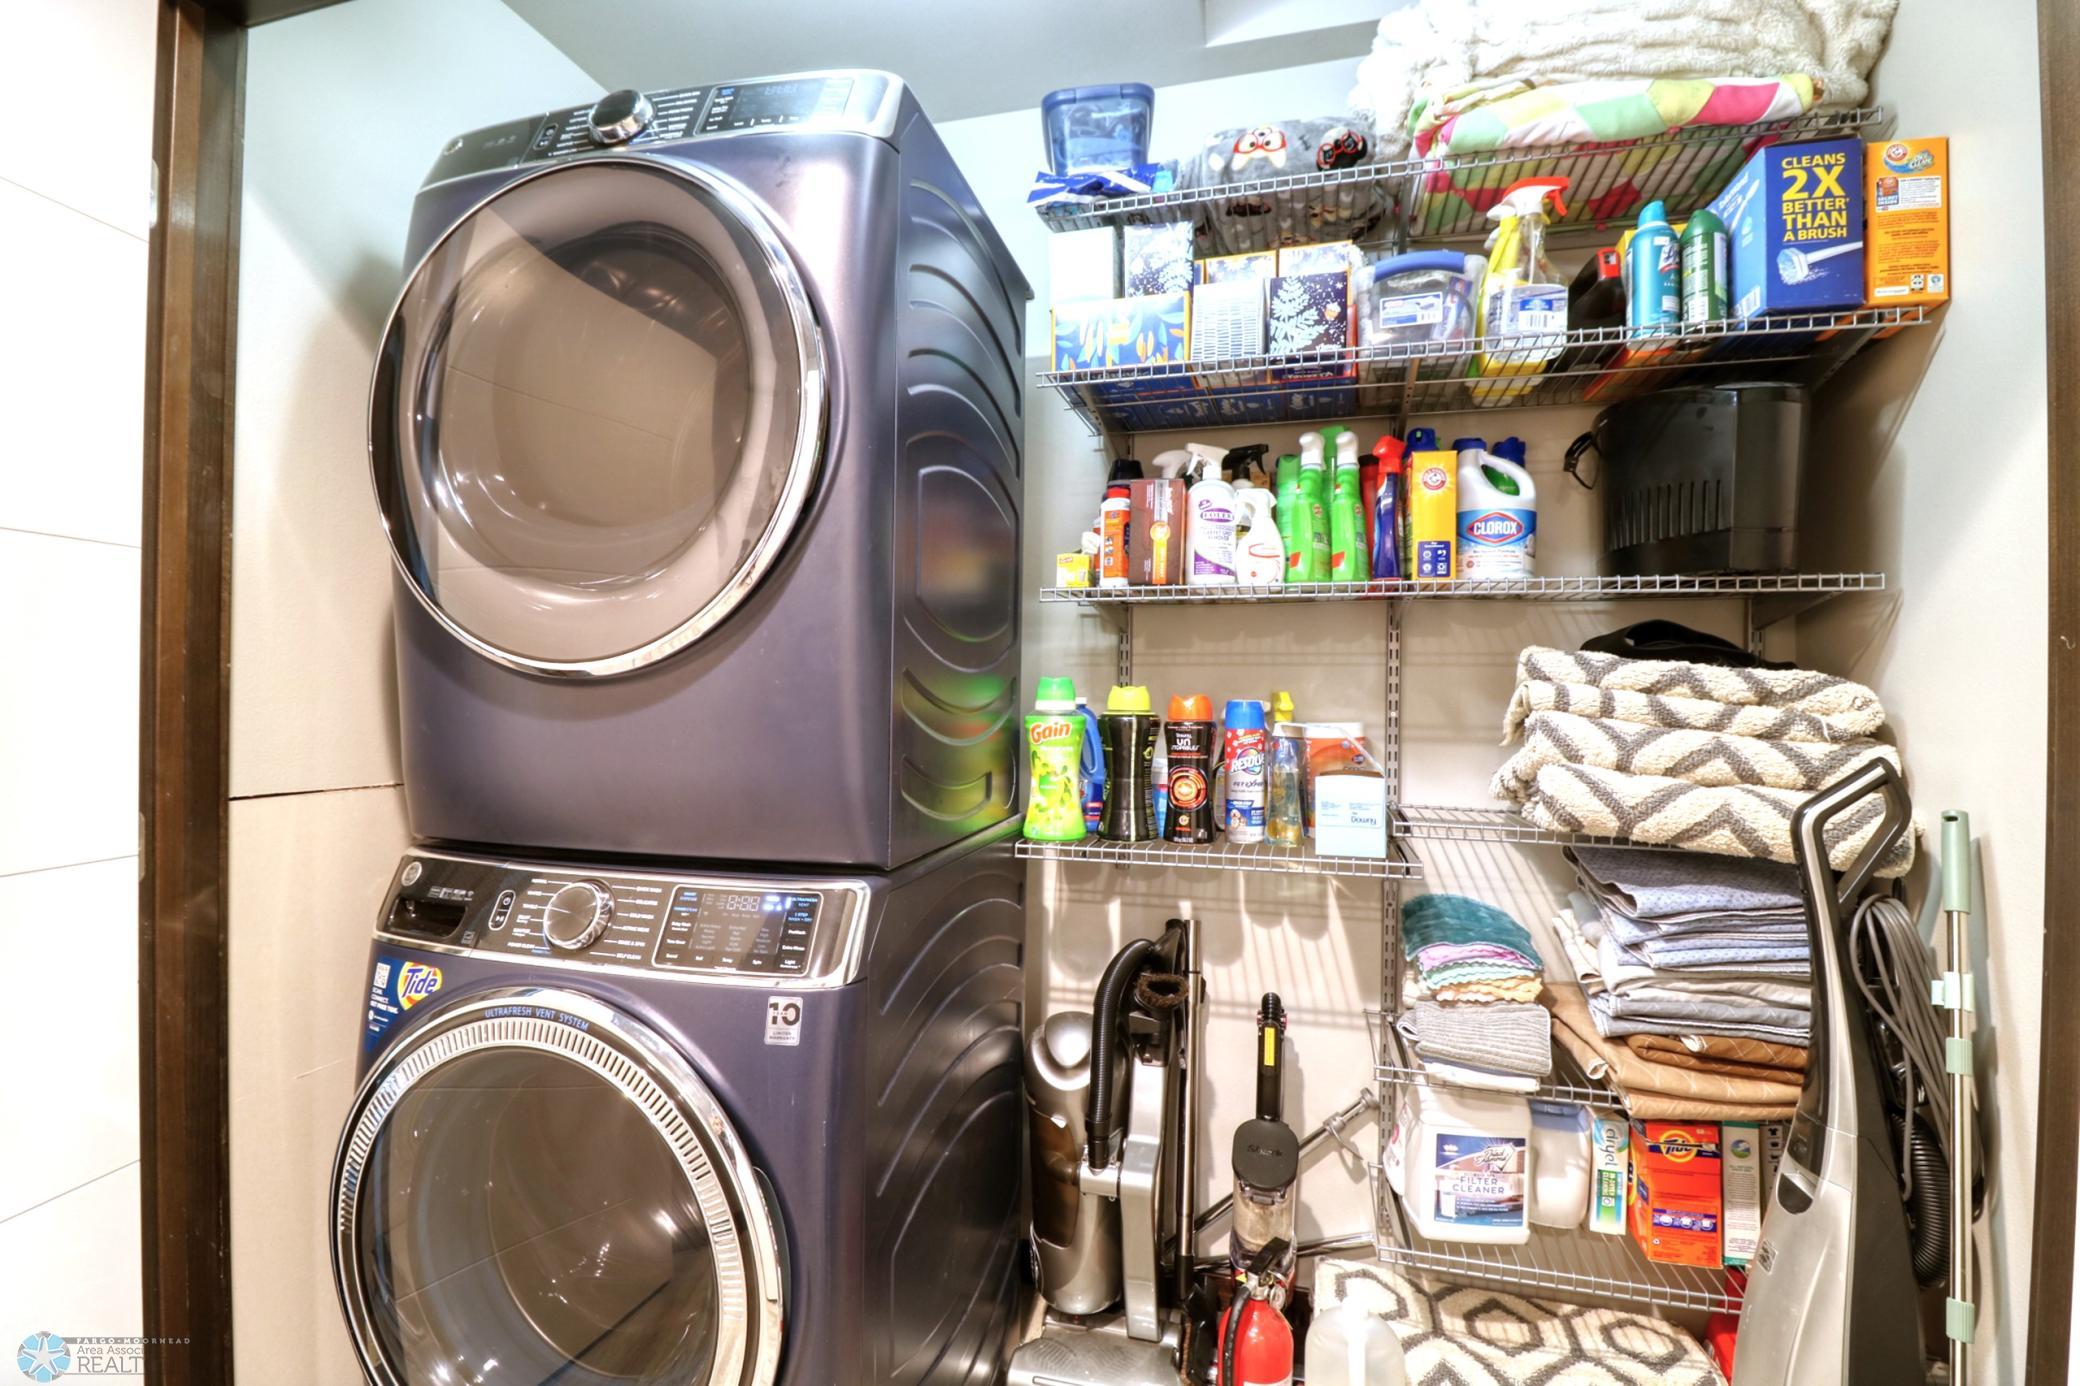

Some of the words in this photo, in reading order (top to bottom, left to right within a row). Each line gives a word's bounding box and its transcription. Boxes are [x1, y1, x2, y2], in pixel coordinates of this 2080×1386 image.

[1781, 152, 1846, 169] CLEANS
[1782, 165, 1846, 201] 2X
[1782, 197, 1847, 214] BETTER
[1782, 210, 1847, 230] THAN
[1783, 230, 1795, 241] A
[1797, 227, 1847, 241] BRUSH
[1473, 520, 1517, 535] CLOROX
[1030, 721, 1071, 744] Gain
[401, 968, 438, 998] Tide
[485, 1006, 532, 1018] ULTRAFRESH
[535, 1008, 557, 1020] VENT
[559, 1013, 589, 1031] SYSTEM
[769, 1002, 801, 1026] 10
[1598, 1128, 1618, 1167] dryel
[1452, 1184, 1505, 1194] CLEANER
[1460, 1176, 1498, 1185] FILTER
